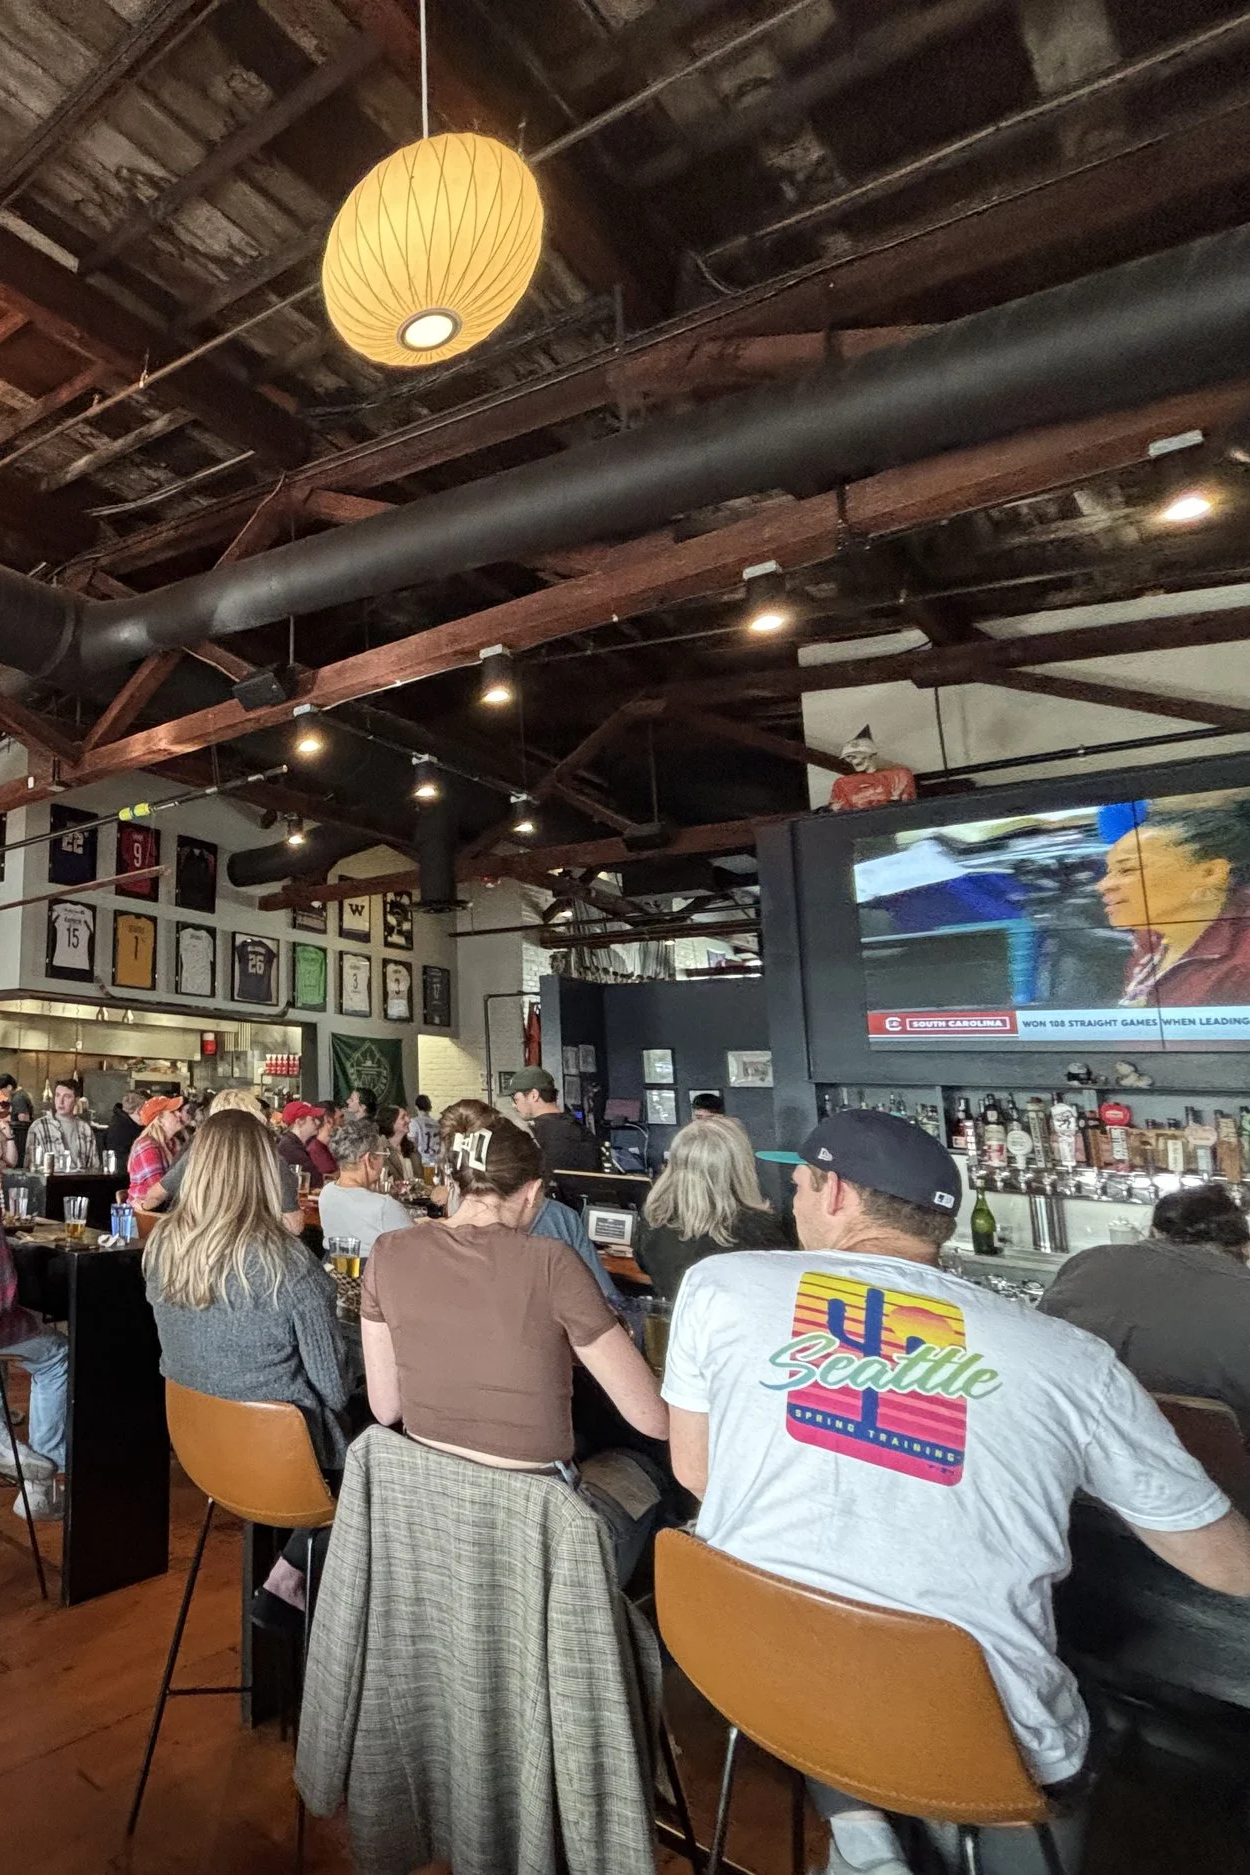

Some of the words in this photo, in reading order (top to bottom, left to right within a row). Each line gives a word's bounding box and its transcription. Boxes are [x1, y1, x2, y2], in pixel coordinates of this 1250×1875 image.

[133, 843, 142, 867] 9
[347, 903, 365, 917] W
[66, 927, 80, 949] 15
[133, 935, 140, 961] 1
[247, 955, 265, 975] 26
[912, 1020, 947, 1028] SOUTH
[948, 1019, 1003, 1027] CAROLINA
[1022, 1020, 1047, 1028] WON
[1068, 1019, 1118, 1028] STRAIGHT
[1121, 1018, 1158, 1027] GAMES
[1161, 1018, 1197, 1026] WHEN
[1199, 1017, 1250, 1026] LEADING
[759, 1331, 1003, 1400] Seattle
[795, 1409, 855, 1433] SPRING
[867, 1429, 955, 1462] TRAINING
